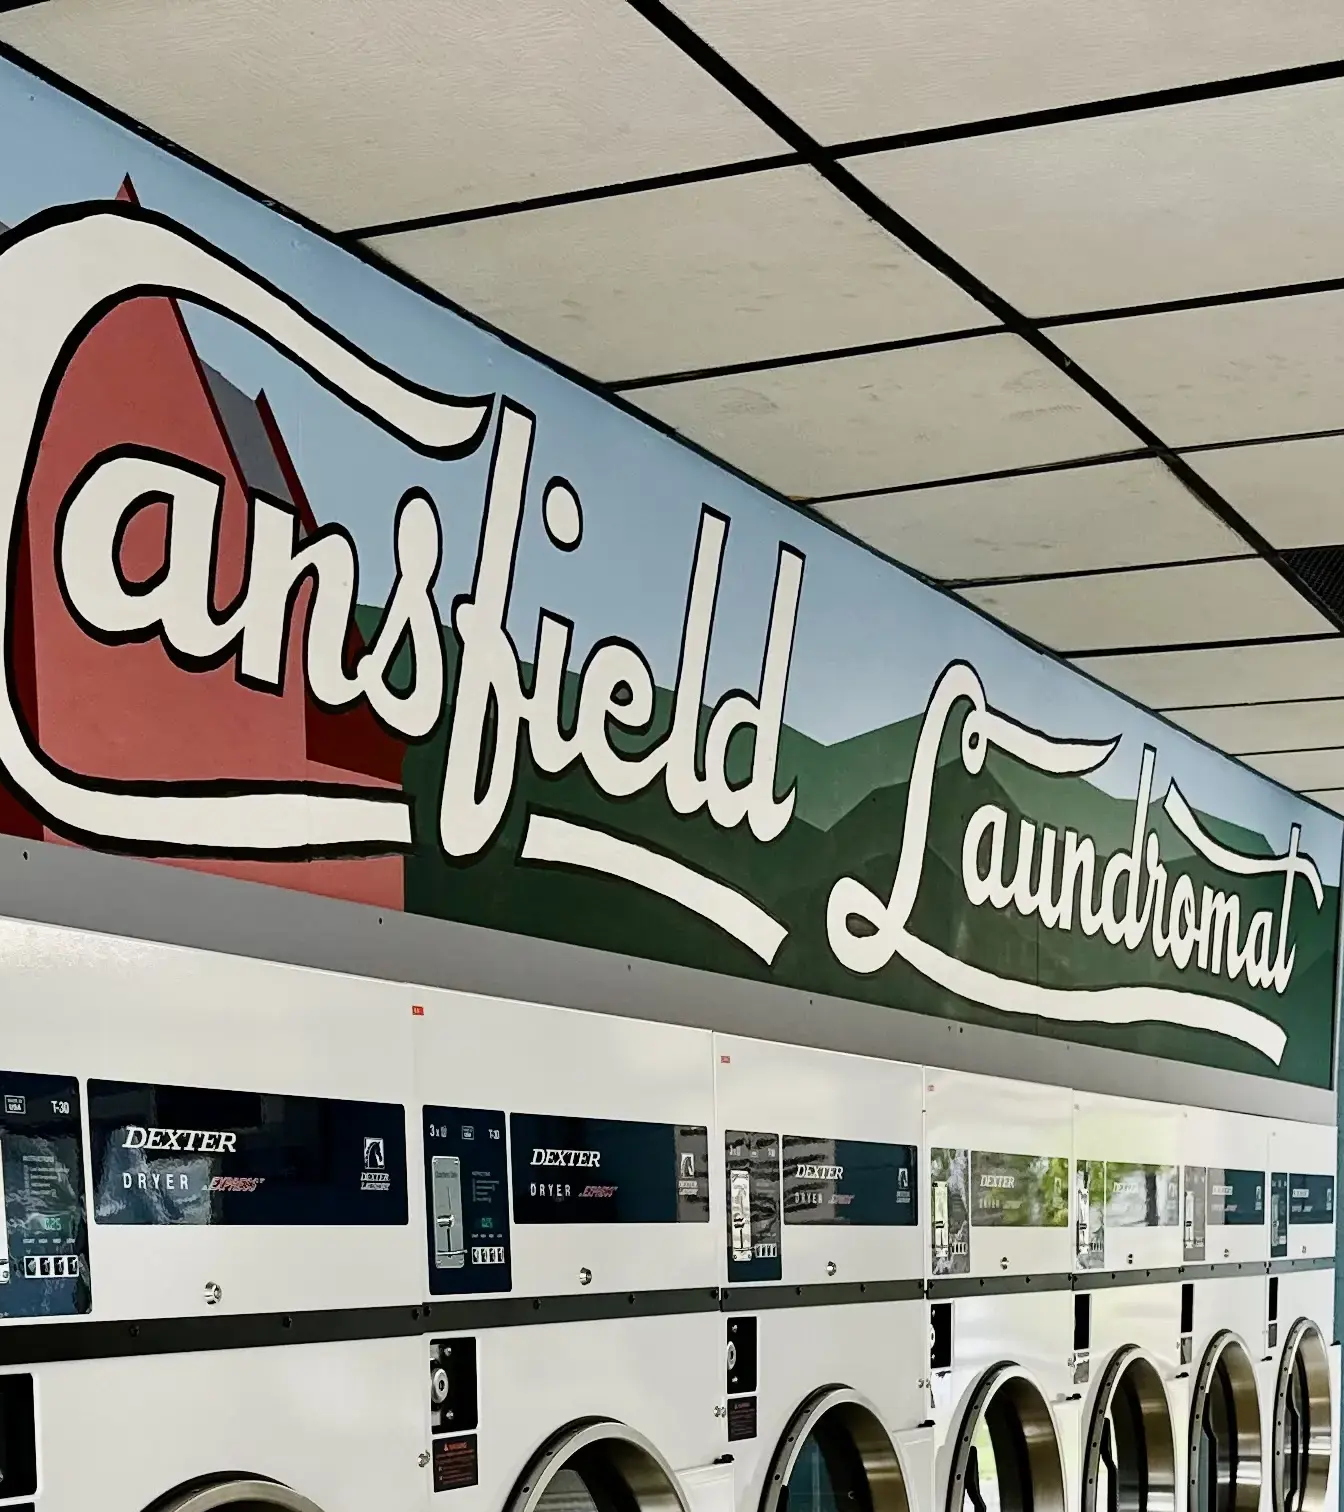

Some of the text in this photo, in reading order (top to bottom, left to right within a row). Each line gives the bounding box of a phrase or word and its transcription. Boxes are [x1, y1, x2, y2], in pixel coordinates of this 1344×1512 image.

[828, 660, 1324, 1062] Laundromat
[51, 1101, 69, 1114] T-30
[430, 1124, 434, 1136] 3
[122, 1126, 236, 1152] DEXTER
[530, 1149, 600, 1167] DEXTER
[360, 1172, 388, 1182] DEXTER
[795, 1164, 843, 1180] DEXTER
[122, 1172, 189, 1190] DRYER
[980, 1175, 1015, 1188] DEXTER
[530, 1184, 571, 1196] DRYER
